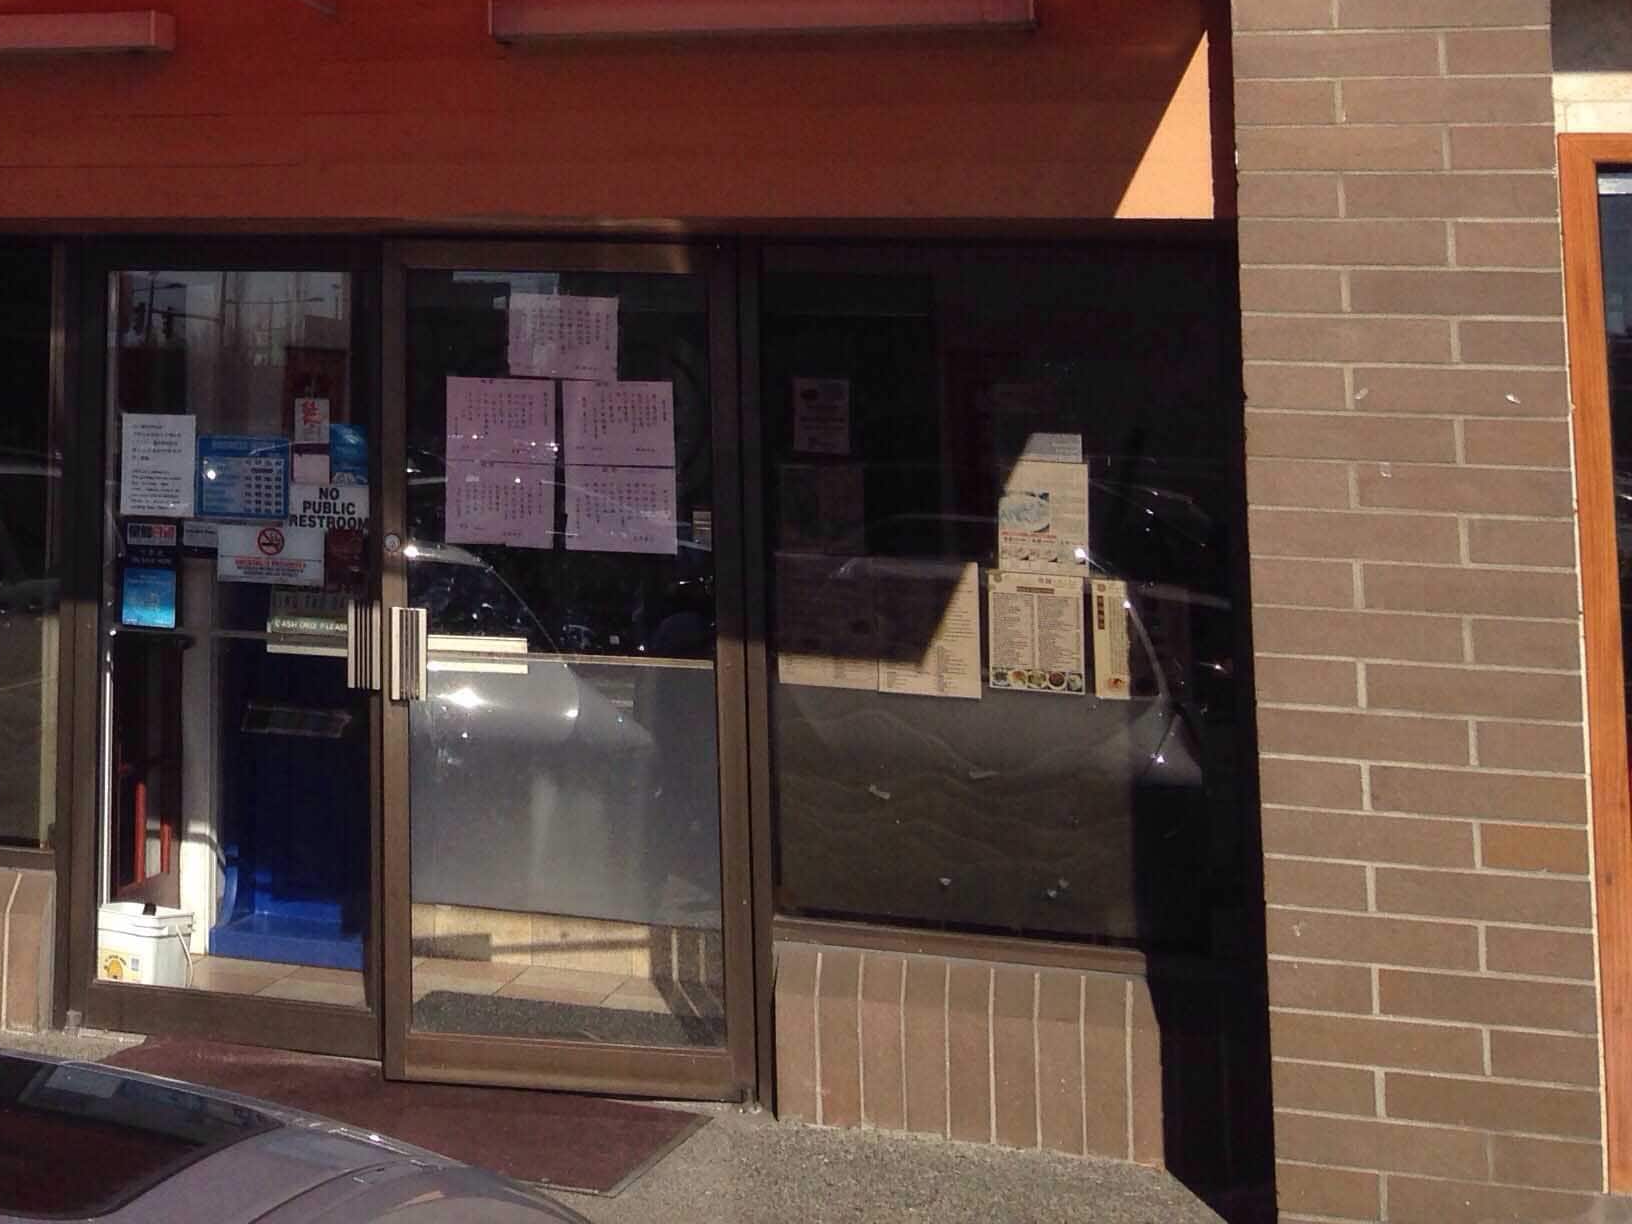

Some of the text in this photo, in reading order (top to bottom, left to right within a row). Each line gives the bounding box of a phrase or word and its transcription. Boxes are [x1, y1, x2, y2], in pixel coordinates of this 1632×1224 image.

[319, 487, 340, 501] NO
[302, 500, 356, 516] PUBLIC
[288, 514, 369, 530] RESTROOM
